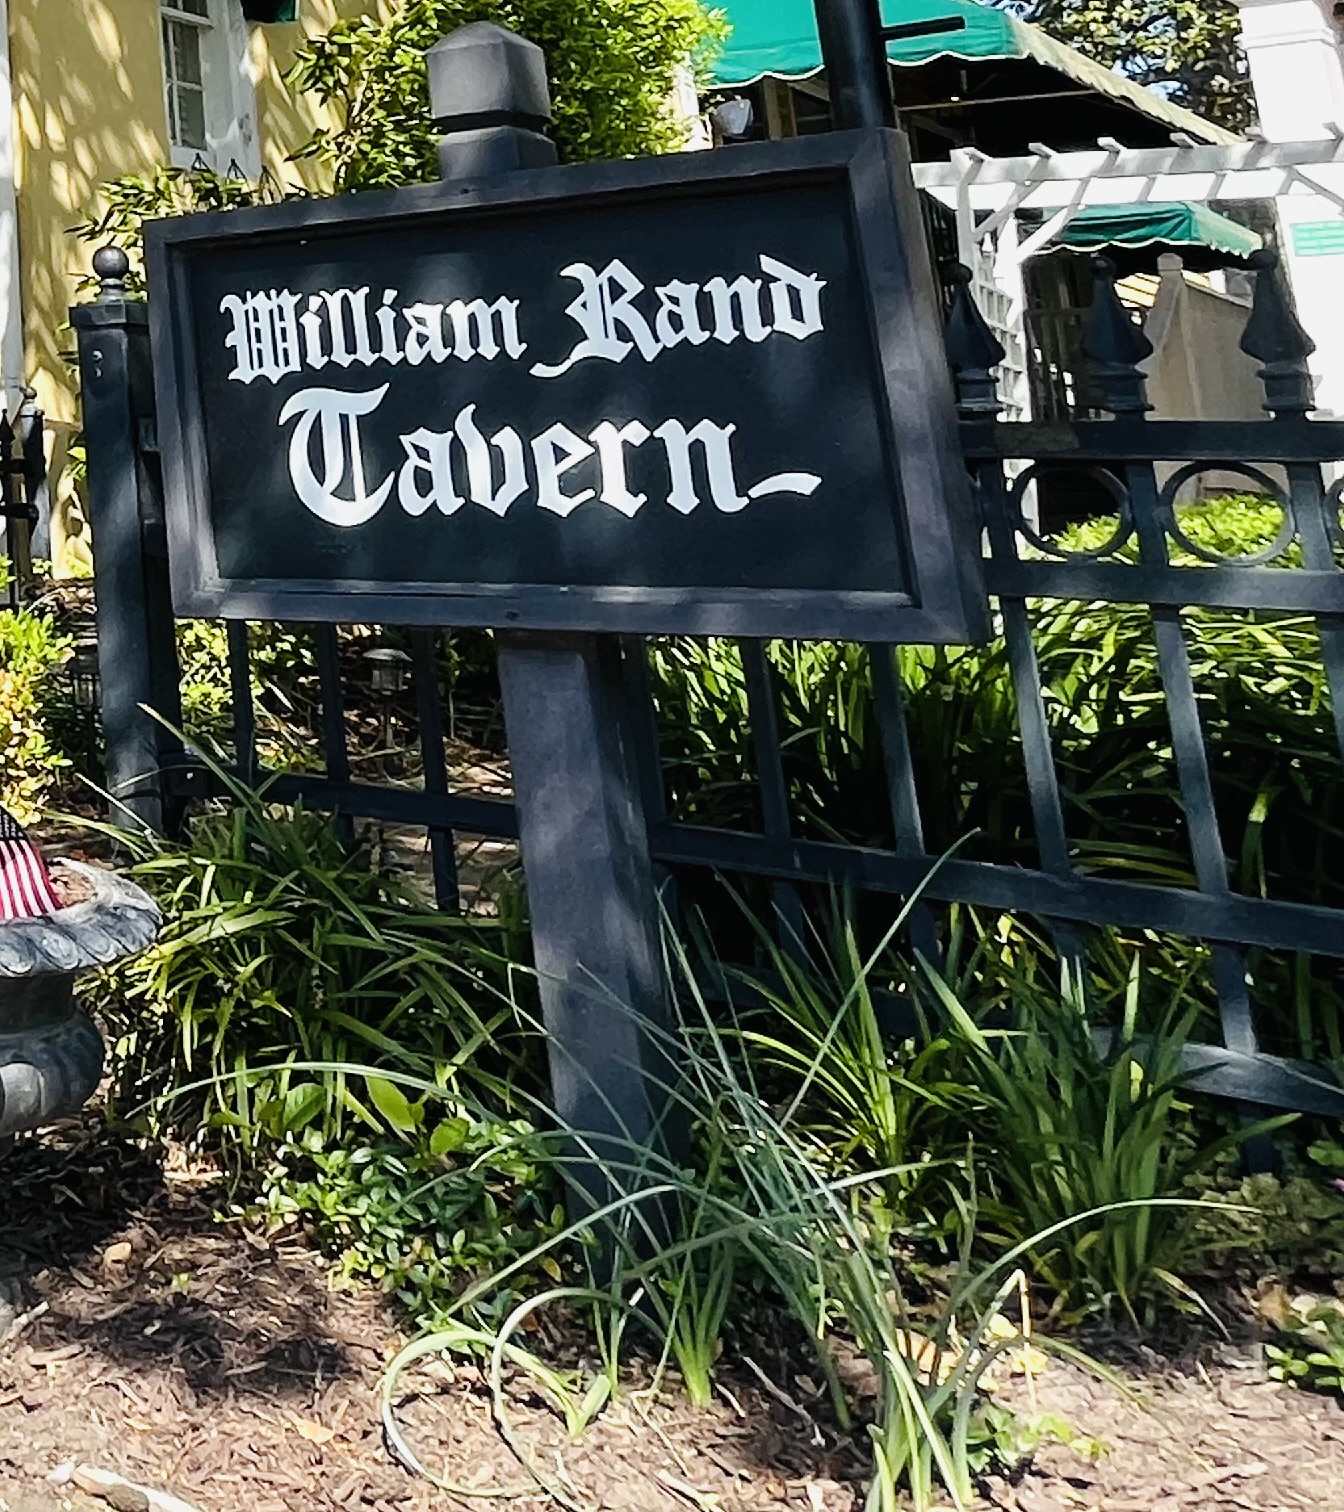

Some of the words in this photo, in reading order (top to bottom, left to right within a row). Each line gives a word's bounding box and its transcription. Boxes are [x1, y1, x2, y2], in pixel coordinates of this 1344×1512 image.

[219, 284, 528, 385] William
[530, 254, 828, 379] Rand
[279, 382, 822, 528] Tavern
